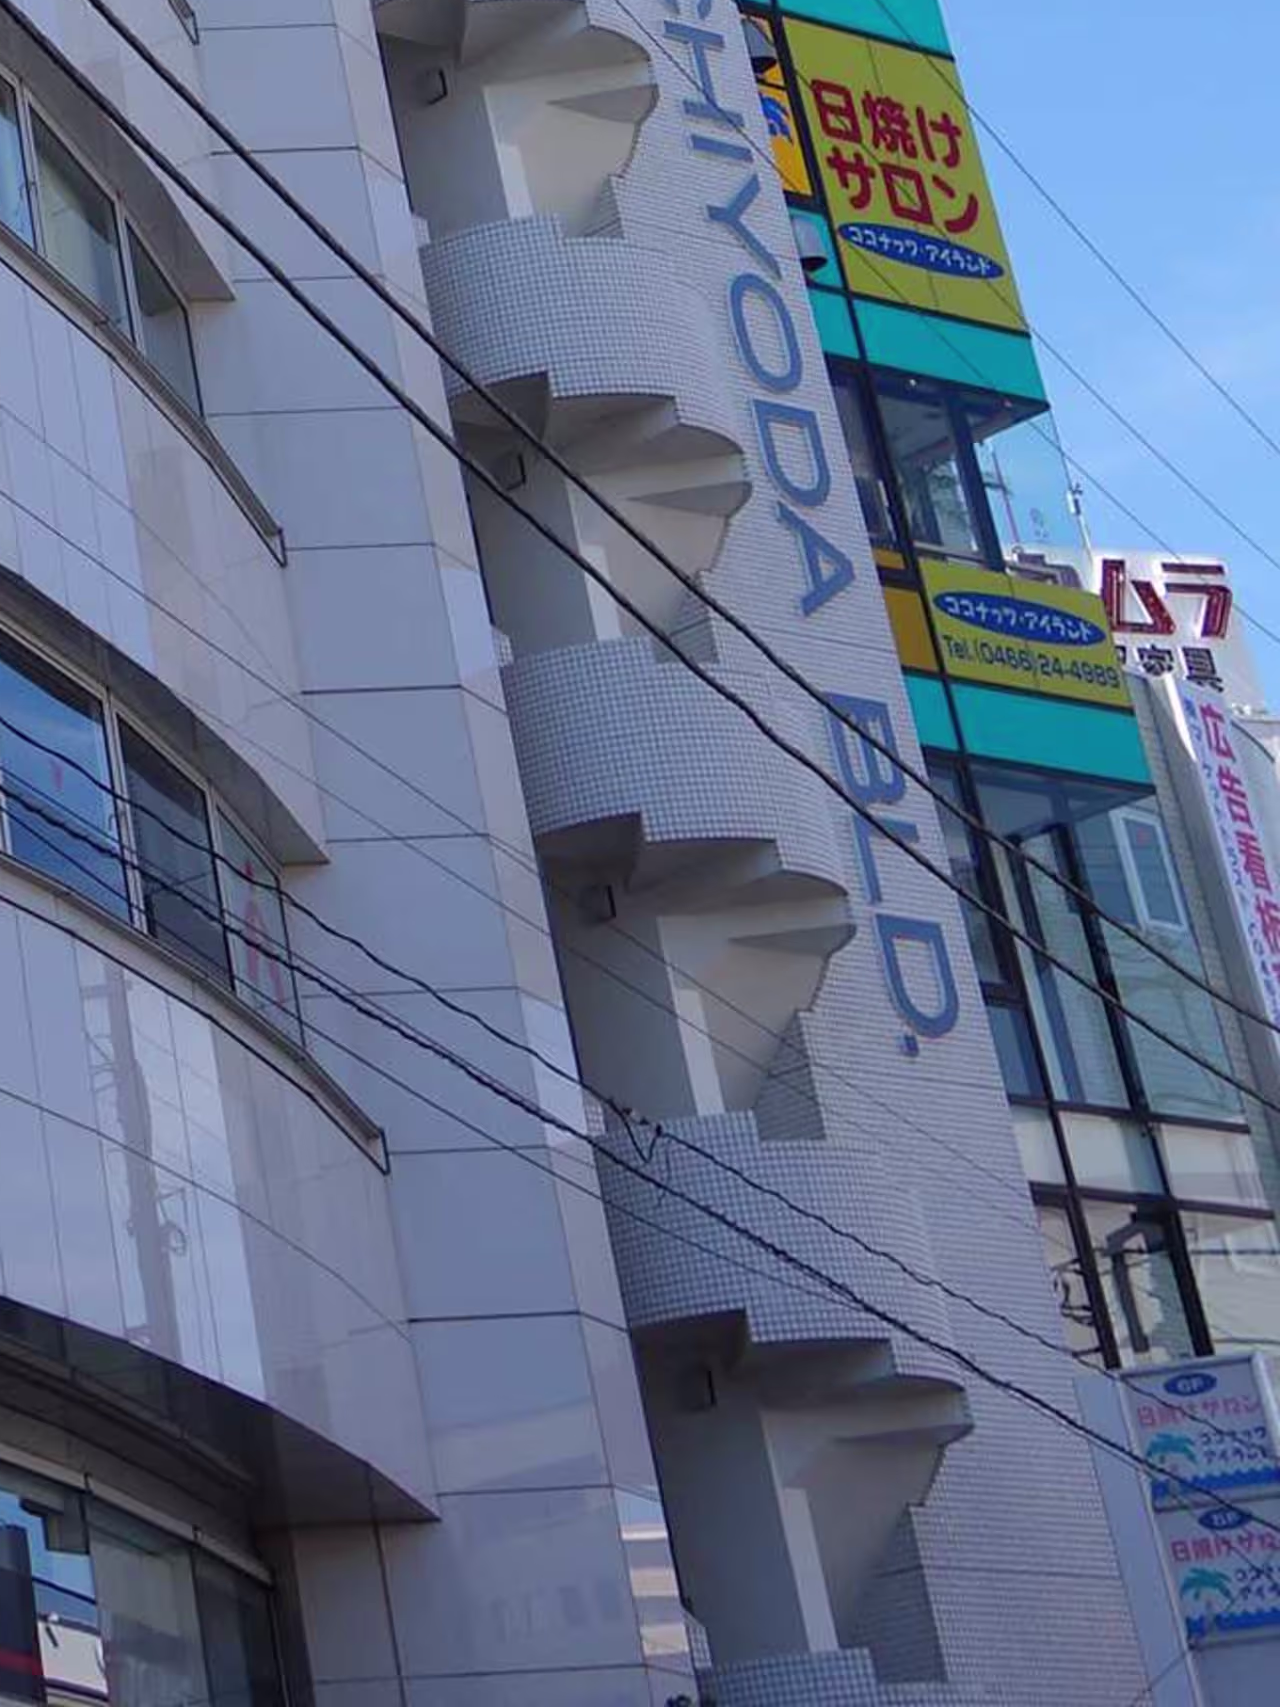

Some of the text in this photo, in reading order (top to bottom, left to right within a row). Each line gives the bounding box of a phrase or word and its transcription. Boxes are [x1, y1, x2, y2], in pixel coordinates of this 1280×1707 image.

[810, 78, 963, 168] 日焼け
[826, 146, 980, 235] サロン
[824, 692, 959, 1057] BLD.
